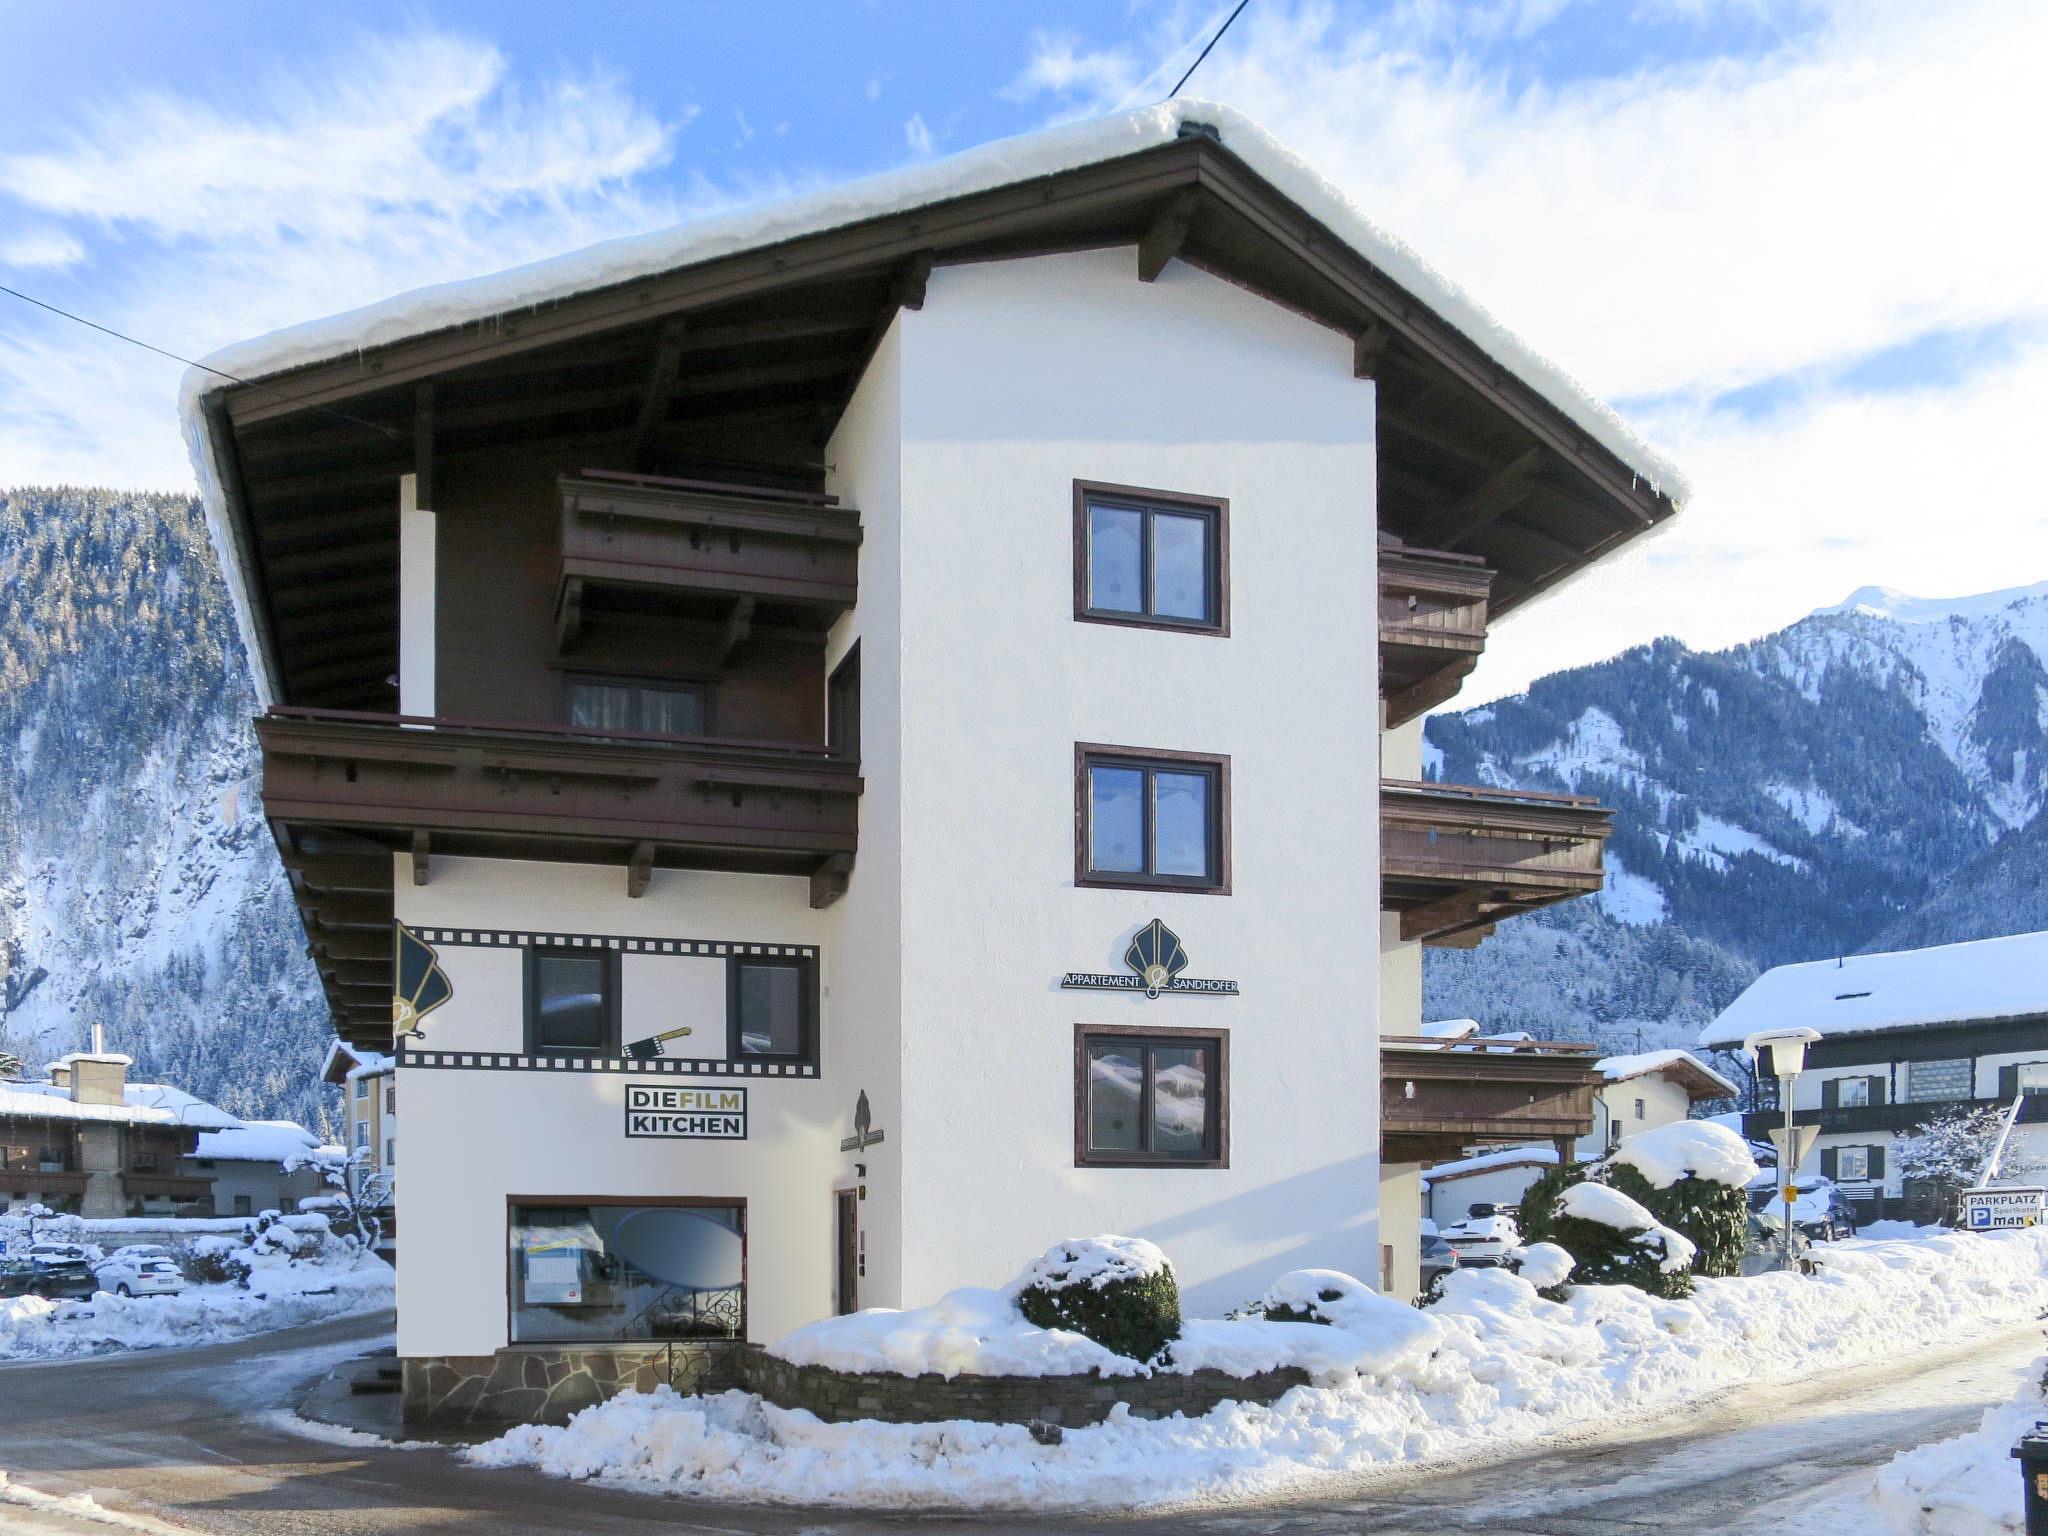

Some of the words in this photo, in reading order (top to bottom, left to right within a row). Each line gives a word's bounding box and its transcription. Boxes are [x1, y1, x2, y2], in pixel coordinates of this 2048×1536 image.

[1063, 974, 1140, 987] APPARTEMENT
[1173, 980, 1239, 991] SANDHOFER
[633, 1116, 740, 1133] KITCHEN
[1970, 1195, 2037, 1205] PARKPLATZ
[1973, 1210, 1988, 1225] P
